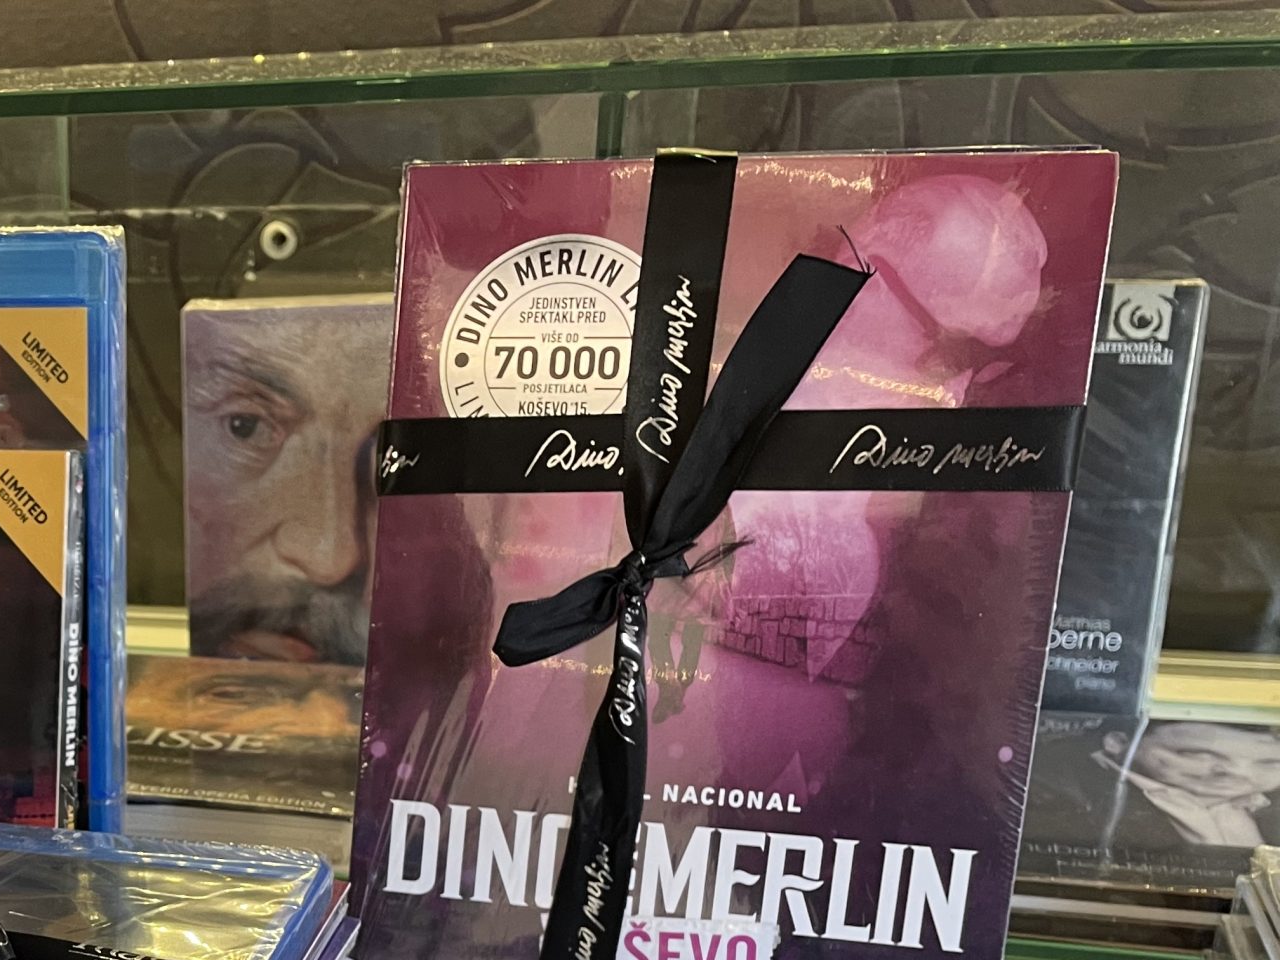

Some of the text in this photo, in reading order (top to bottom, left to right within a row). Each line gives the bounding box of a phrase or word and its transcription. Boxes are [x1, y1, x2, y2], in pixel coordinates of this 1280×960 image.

[456, 248, 624, 345] DINO MERLIN
[529, 297, 597, 310] JEDINSTVEN
[519, 310, 607, 324] SPEKTAKL PRED
[541, 330, 580, 344] VIŠE OD
[1096, 339, 1162, 354] armonia
[21, 350, 52, 383] EDITION
[22, 331, 69, 385] LIMITED
[494, 346, 621, 381] 70 000
[1118, 347, 1174, 365] mundi
[523, 383, 588, 394] POSJETILACA
[518, 397, 567, 416] KOŠEVO
[830, 424, 934, 474] Dino
[0, 468, 48, 525] LIMITED
[68, 622, 81, 681] DINO
[1049, 630, 1122, 652] oerne
[65, 689, 80, 767] MERLIN
[125, 725, 268, 753] LISSE
[663, 783, 802, 813] NACIONAL
[638, 821, 980, 955] MERLIN
